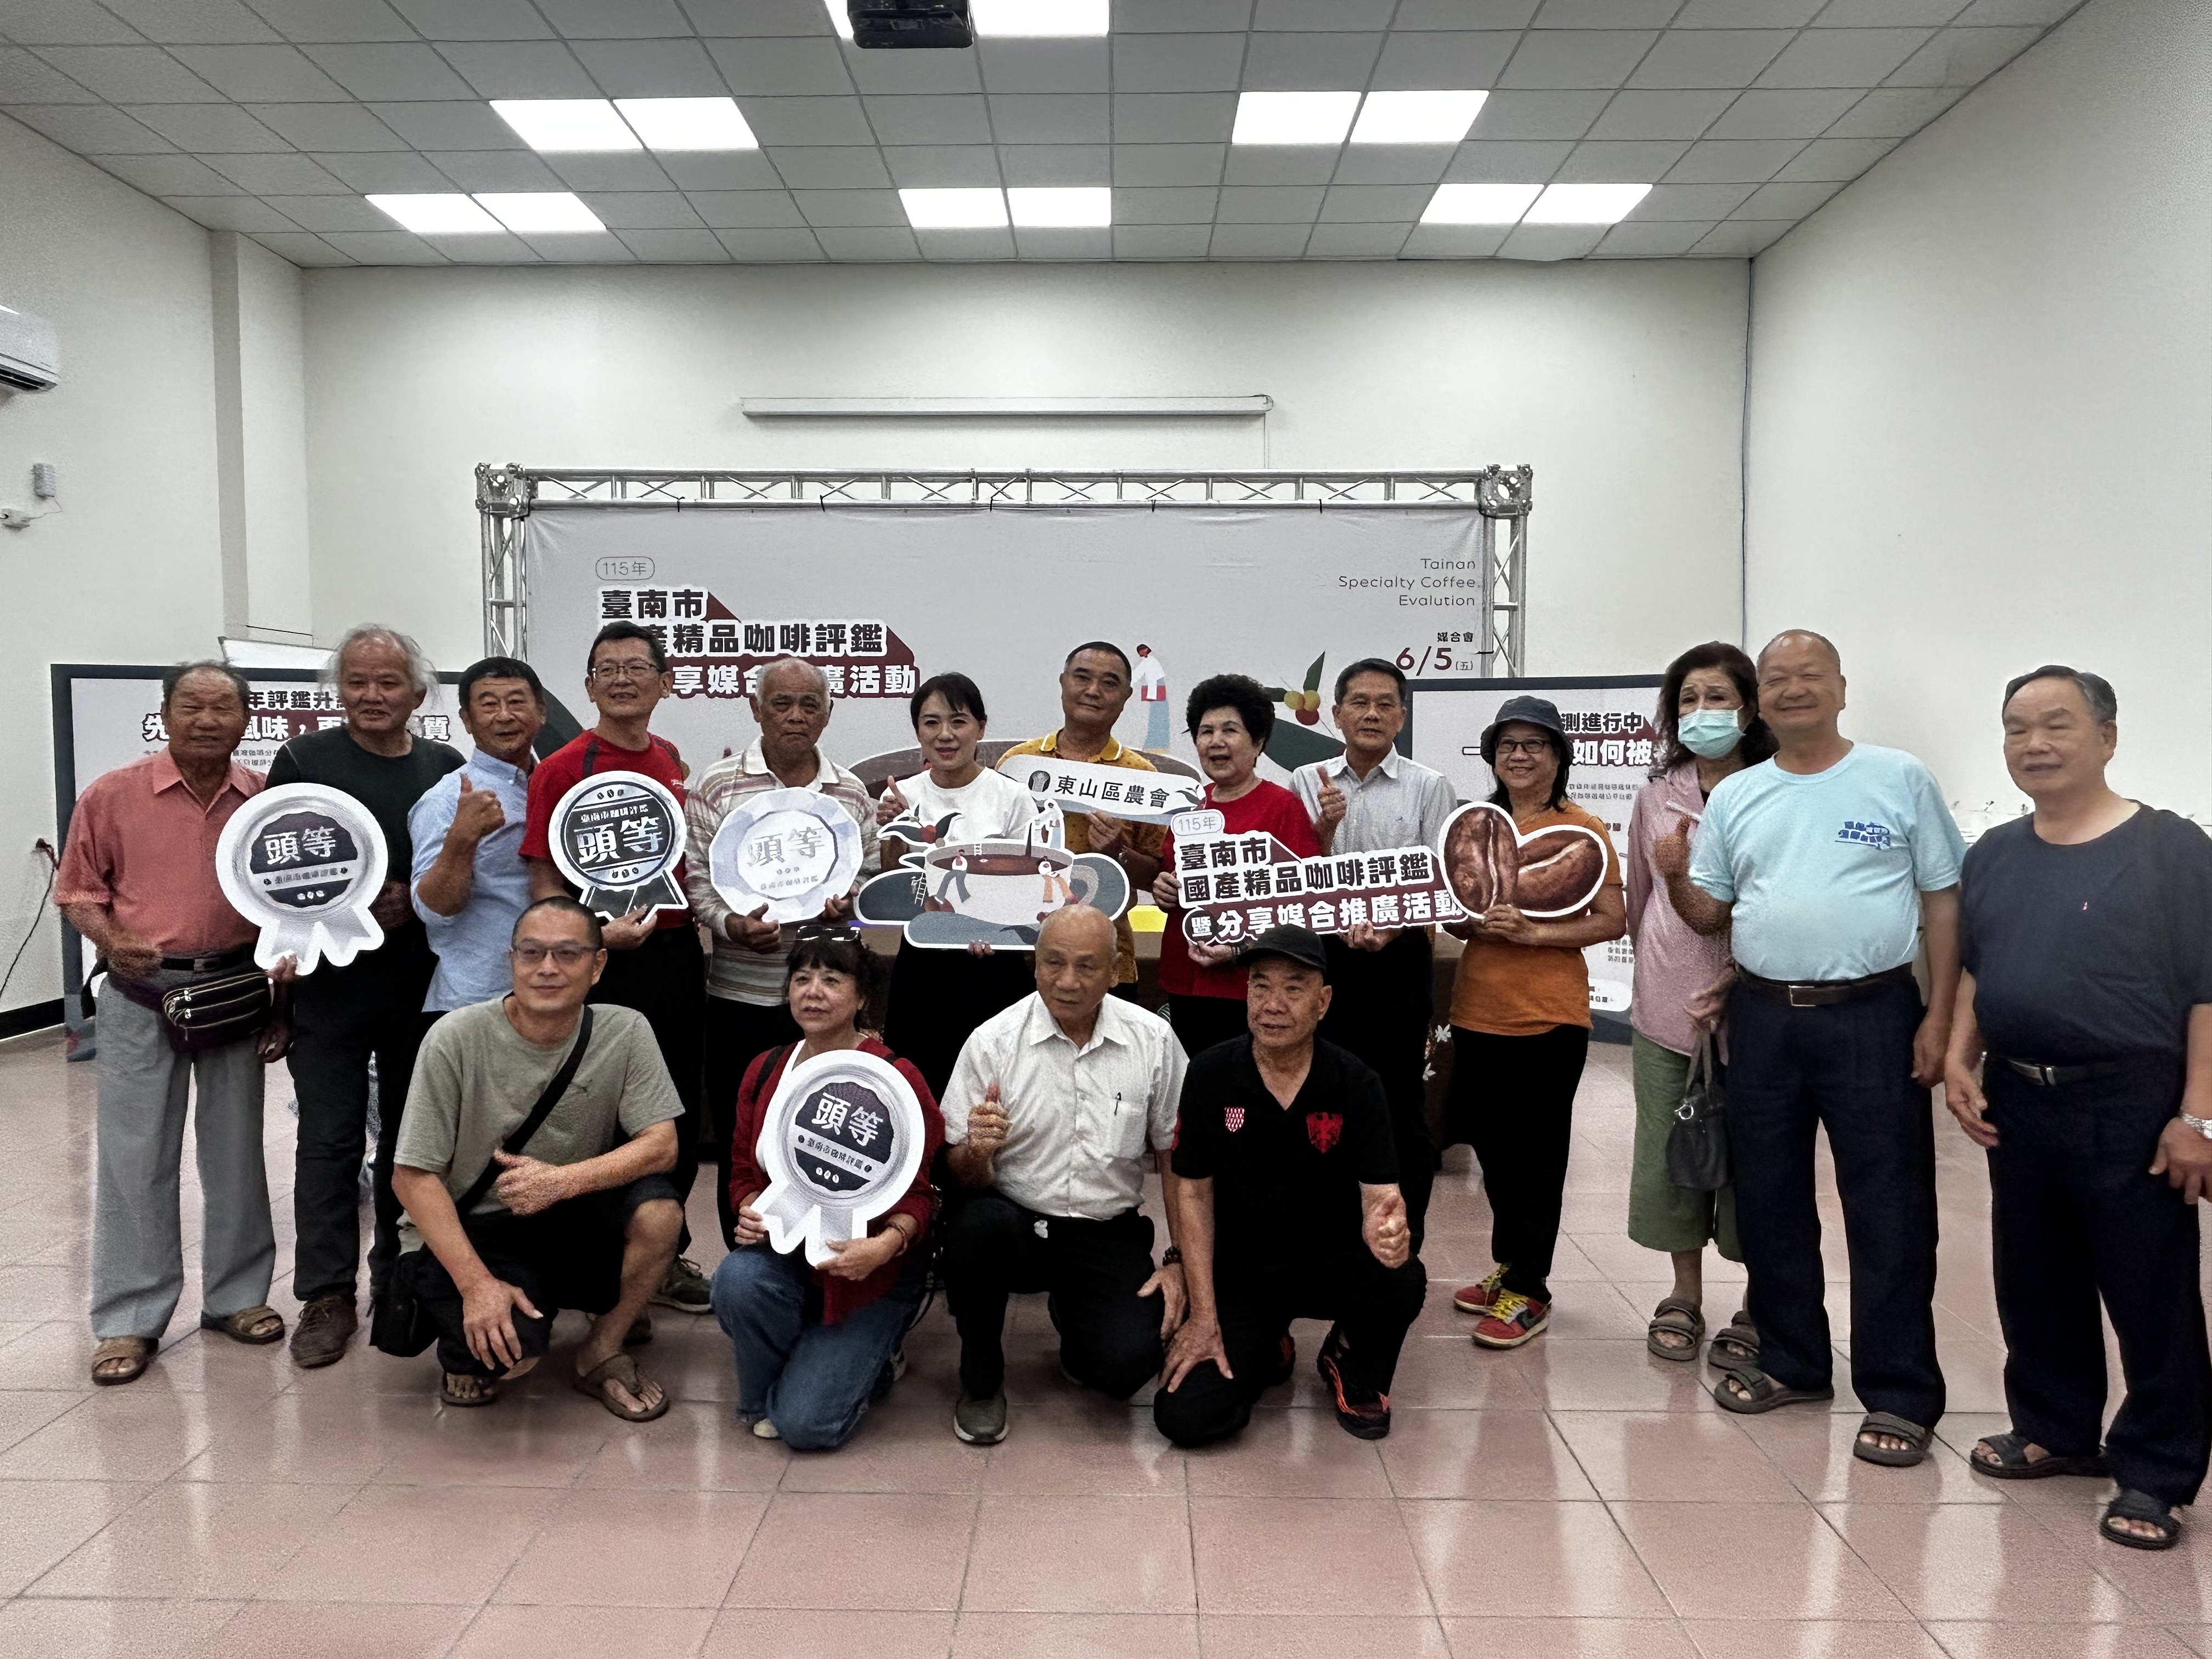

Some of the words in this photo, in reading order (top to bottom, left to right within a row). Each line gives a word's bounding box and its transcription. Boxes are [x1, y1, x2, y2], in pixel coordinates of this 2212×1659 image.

[602, 561, 647, 576] 115年
[1420, 558, 1476, 569] Tainan
[1339, 575, 1415, 590] Specialty
[1420, 576, 1476, 588] Coffee
[601, 589, 704, 619] 臺南市
[1398, 595, 1475, 606] Evalution
[1054, 775, 1170, 809] 東山區農會
[573, 816, 664, 865] 頭等
[1178, 816, 1217, 832] 115年
[263, 826, 336, 865] 頭等
[746, 826, 826, 867] 頭等
[1180, 837, 1267, 871] 臺南市
[1183, 852, 1430, 902] 國產精品咖啡評鑑
[811, 1092, 884, 1147] 頭等
